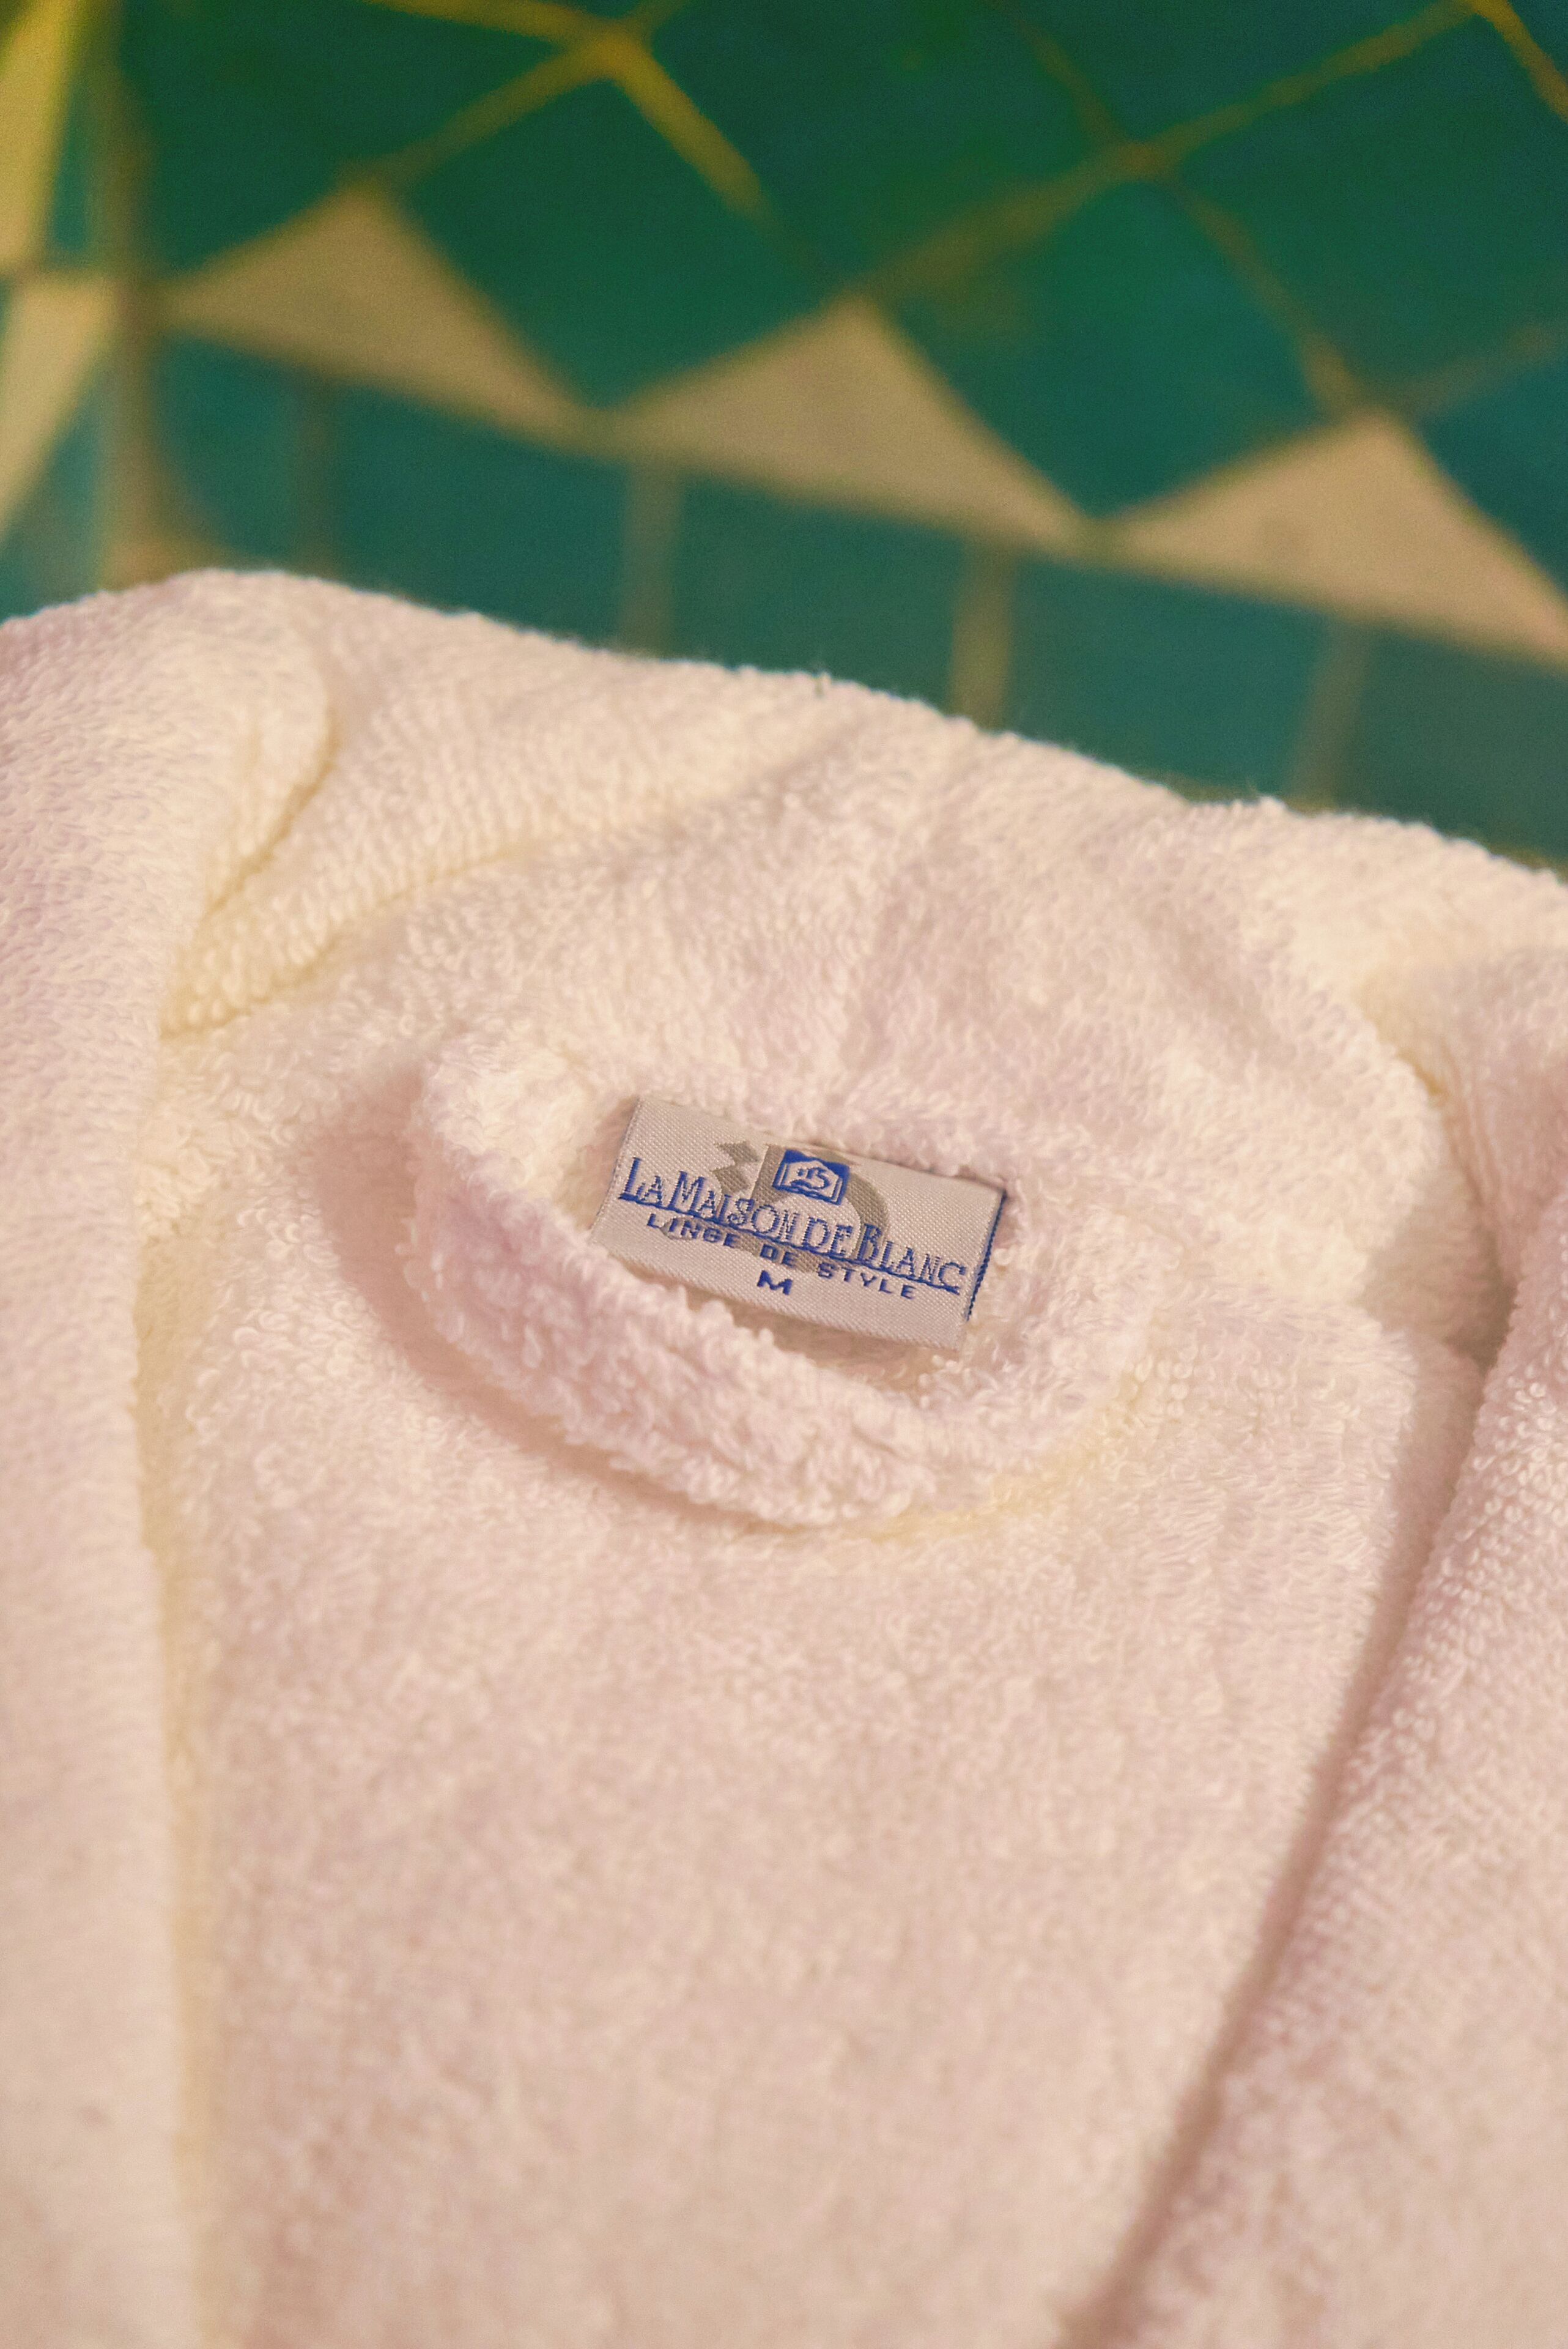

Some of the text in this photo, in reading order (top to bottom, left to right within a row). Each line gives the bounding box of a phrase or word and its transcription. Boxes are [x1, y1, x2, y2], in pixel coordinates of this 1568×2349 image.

[646, 1213, 917, 1299] LINGE DE STYLE
[756, 1269, 794, 1296] M
